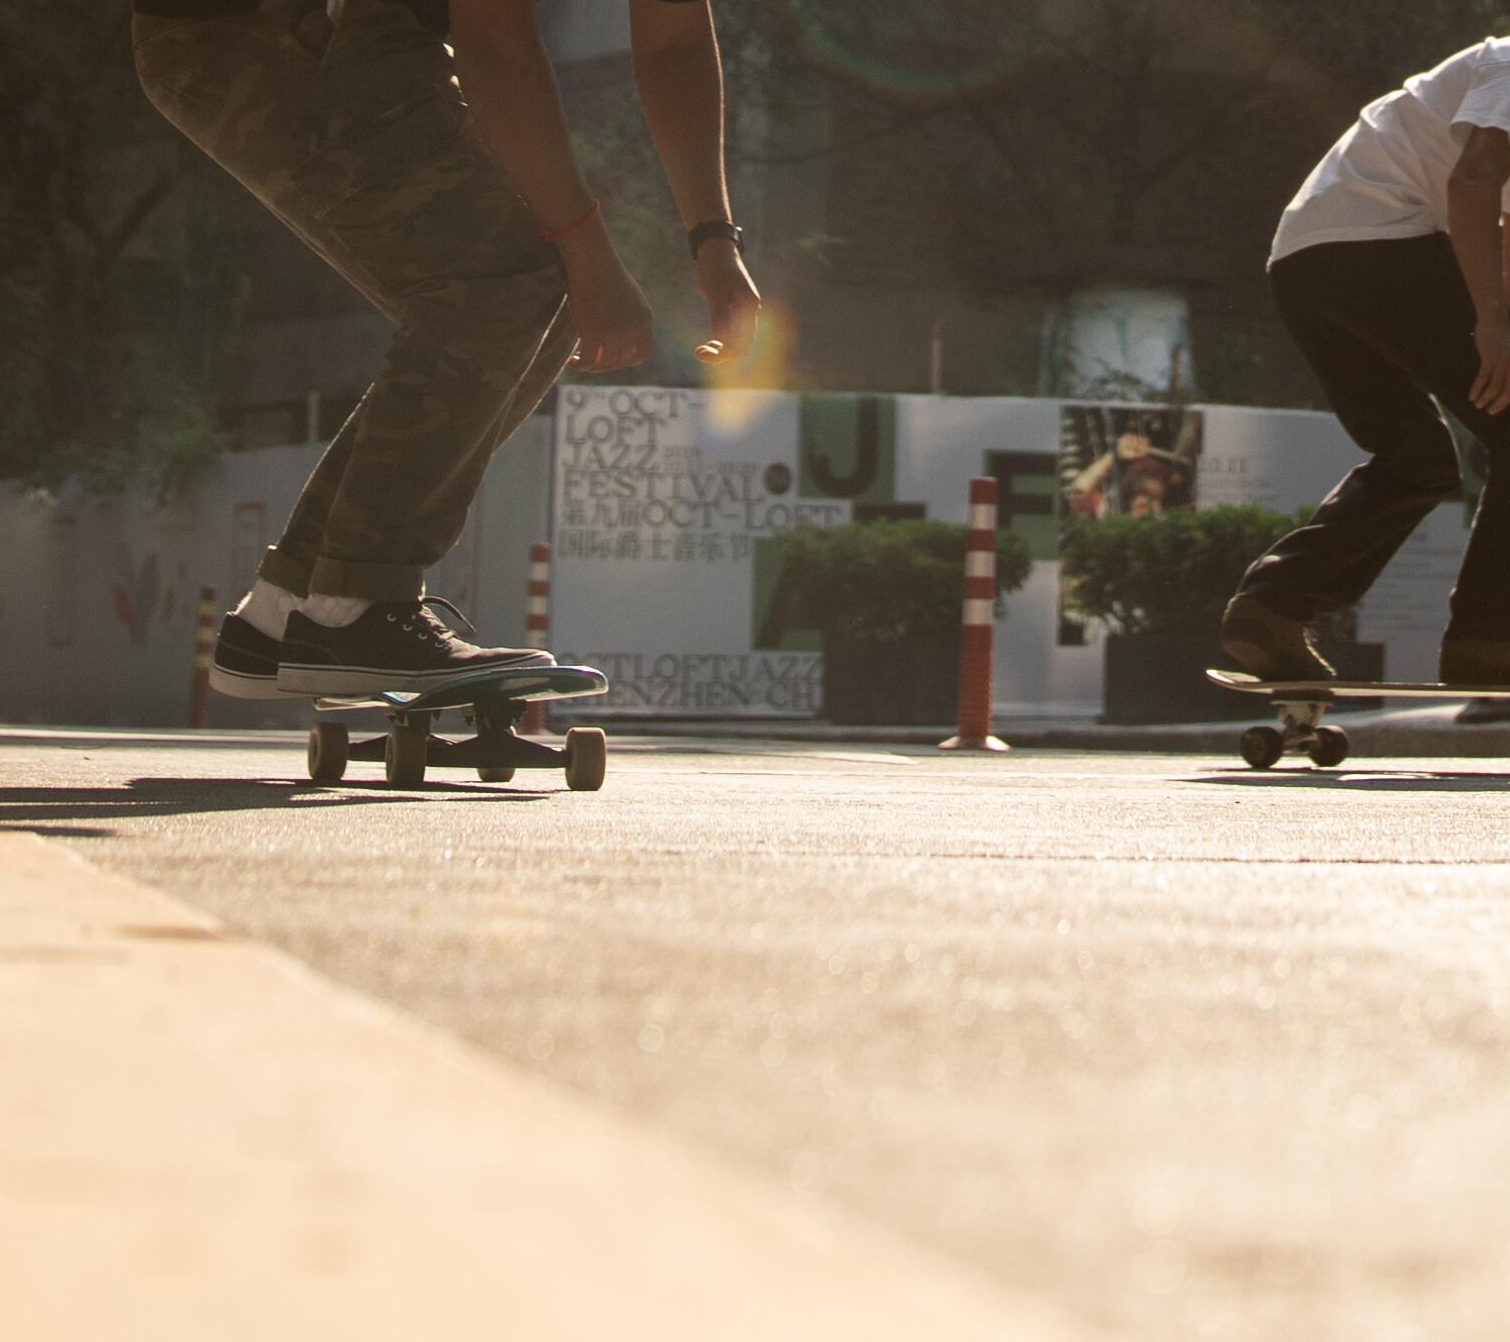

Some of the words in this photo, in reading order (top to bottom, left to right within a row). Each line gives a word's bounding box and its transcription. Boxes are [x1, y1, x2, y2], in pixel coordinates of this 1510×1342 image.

[565, 414, 667, 445] LOFT
[562, 443, 659, 470] JAZZ
[563, 470, 765, 501] FESTIVAL
